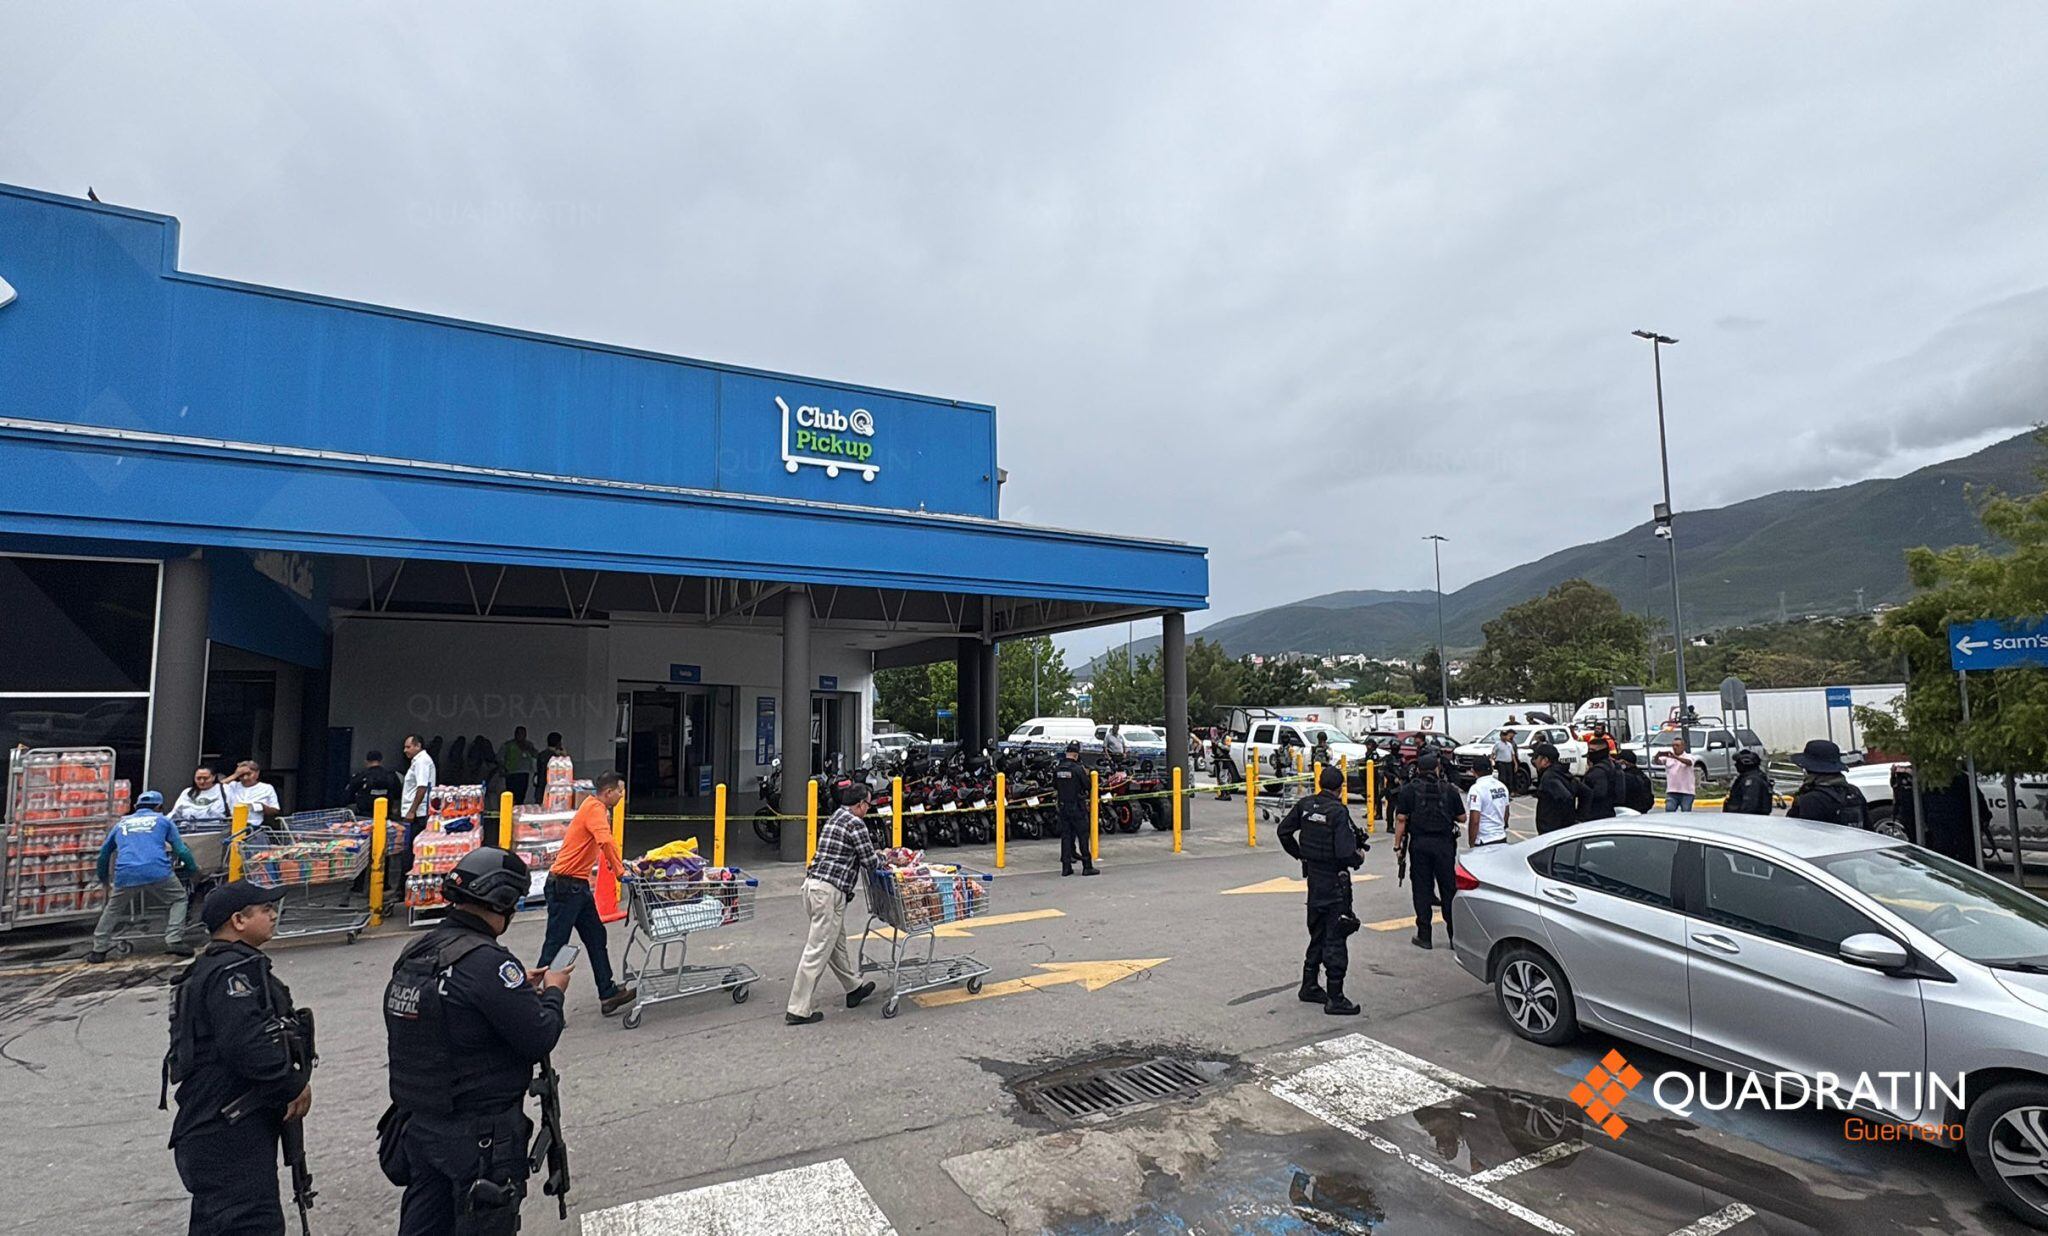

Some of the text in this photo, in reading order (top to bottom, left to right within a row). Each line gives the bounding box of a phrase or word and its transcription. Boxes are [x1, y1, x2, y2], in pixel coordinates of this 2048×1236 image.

[796, 406, 848, 432] Club
[796, 430, 873, 461] Pickup
[1992, 633, 2048, 650] sam's
